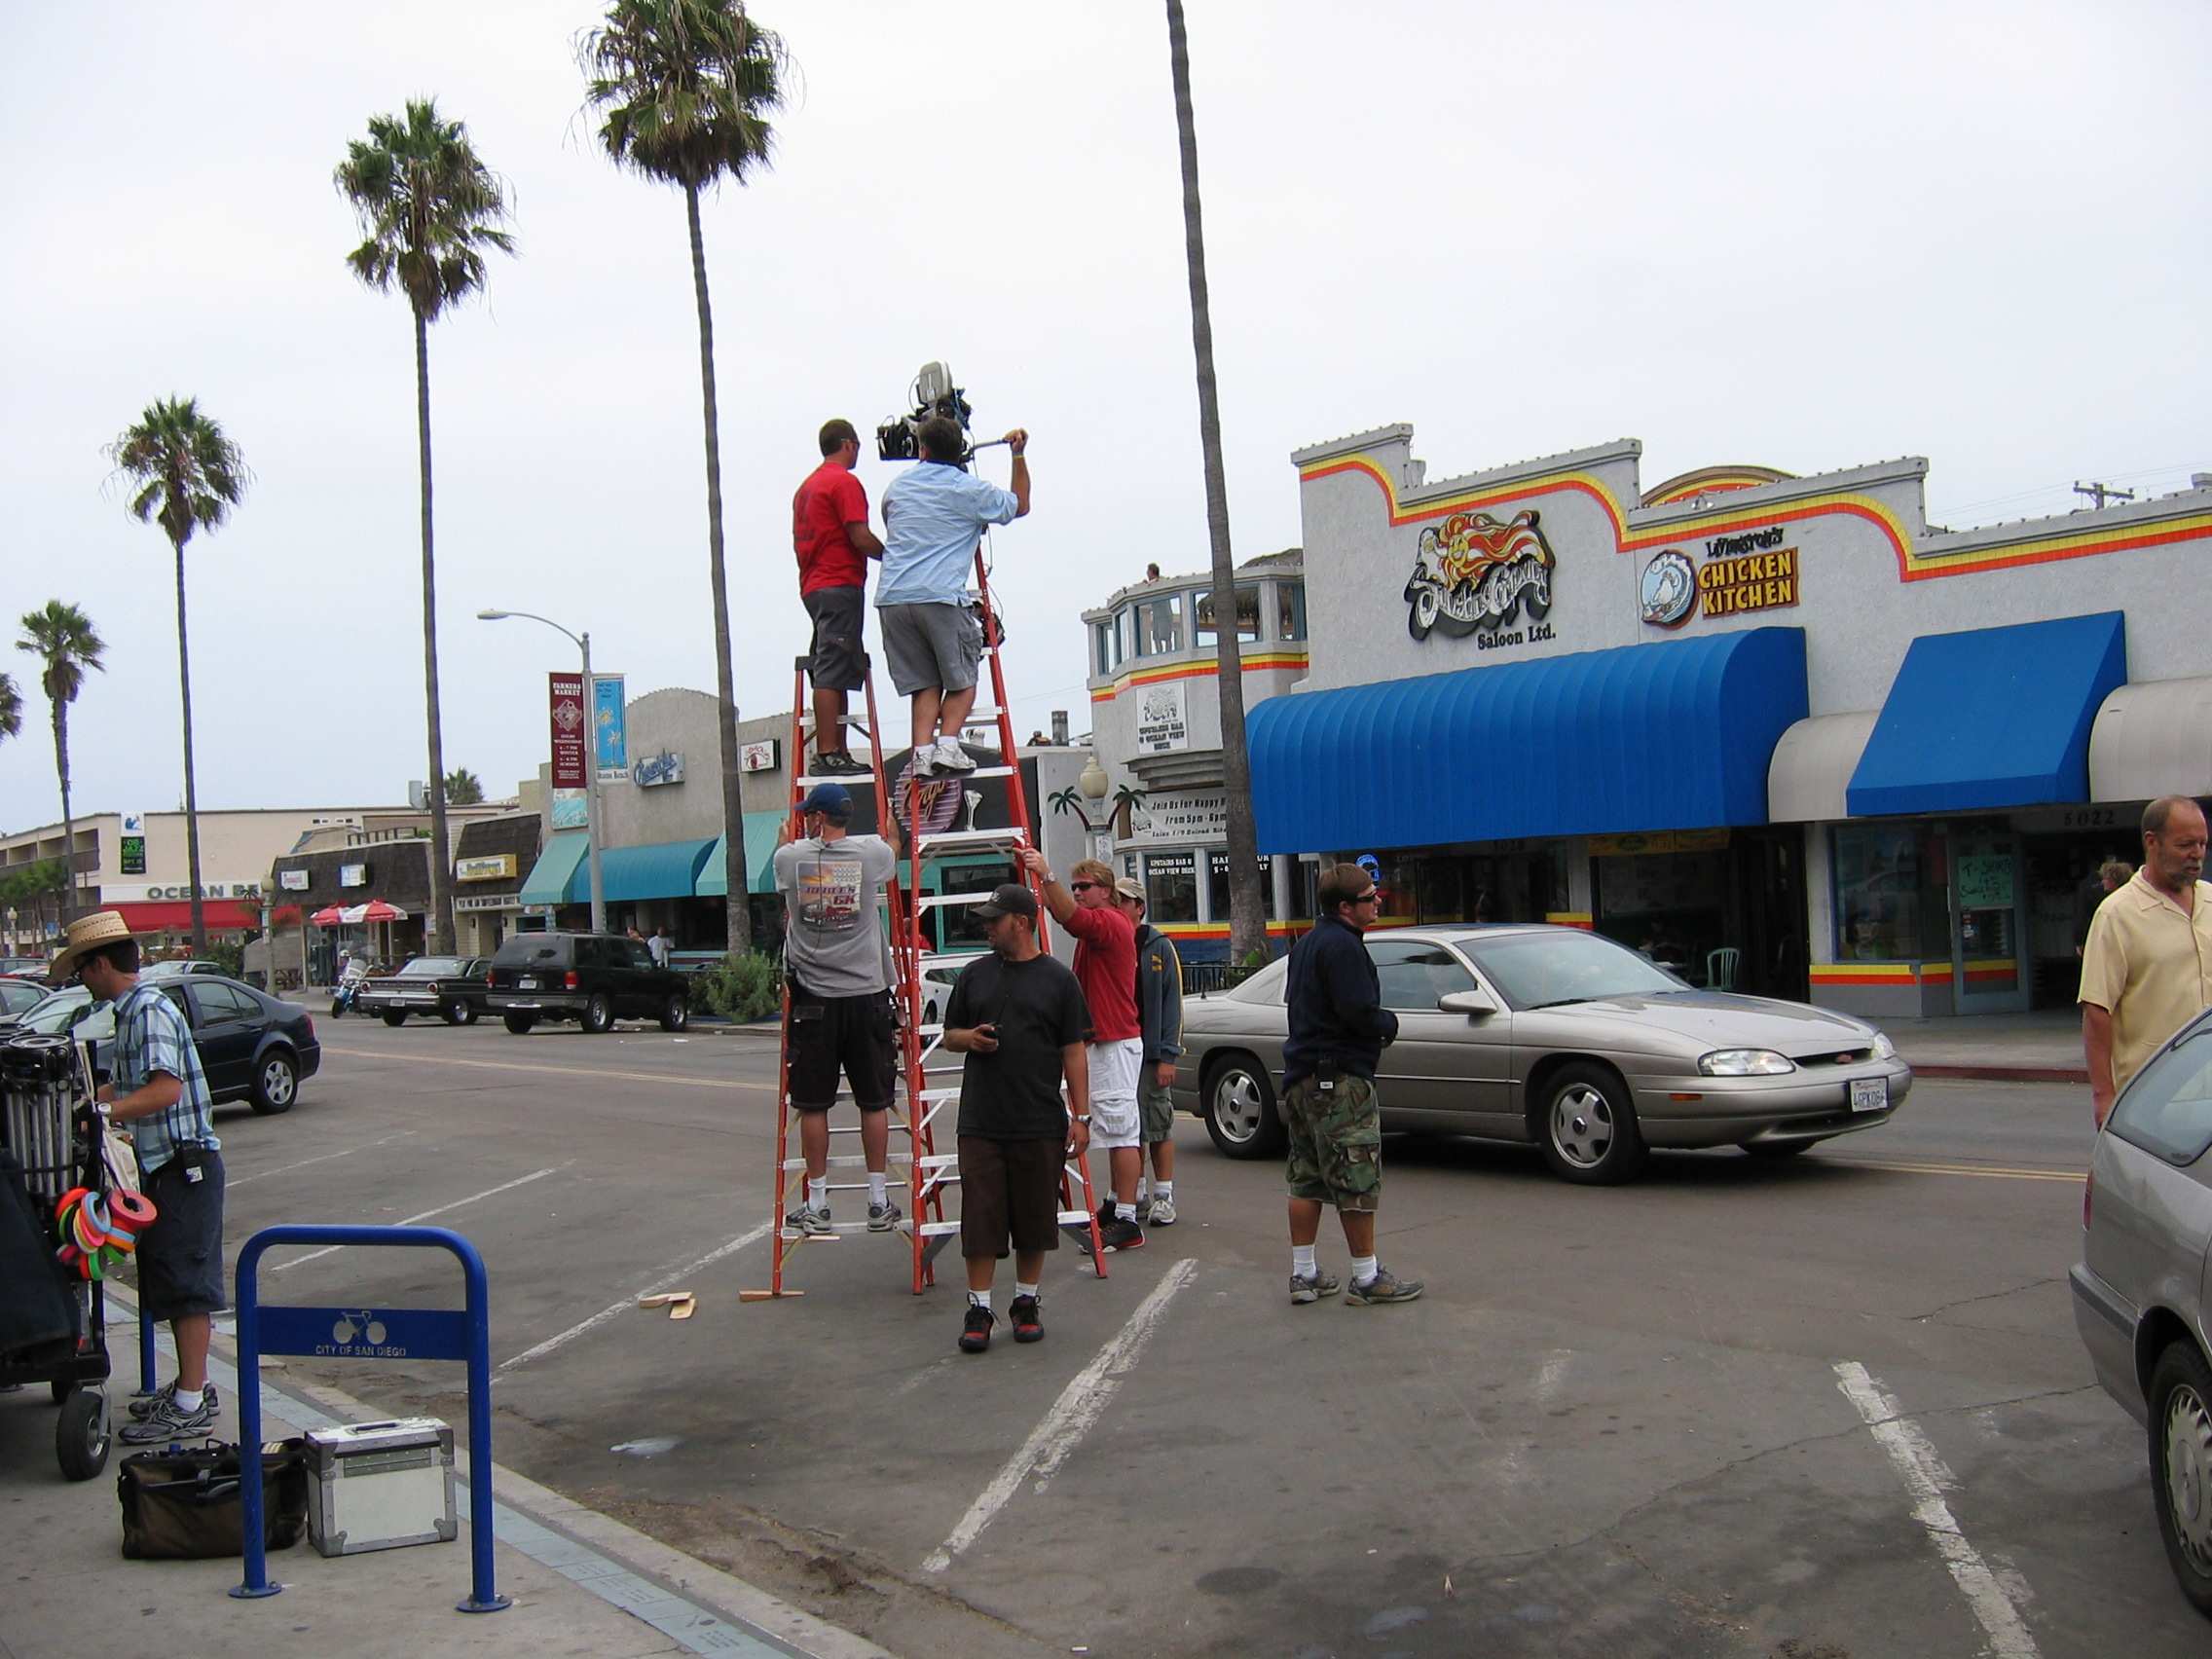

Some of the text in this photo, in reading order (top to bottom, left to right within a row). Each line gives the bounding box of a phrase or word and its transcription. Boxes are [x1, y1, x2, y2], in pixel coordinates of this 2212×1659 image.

[1698, 552, 1792, 589] CHICKEN
[1702, 579, 1792, 615] KITCHEN
[1477, 623, 1557, 650] Saloon Ltd.
[1152, 801, 1167, 810] Join
[1195, 798, 1219, 808] Happy
[315, 1345, 406, 1357] CITY OF SAN DIEGO
